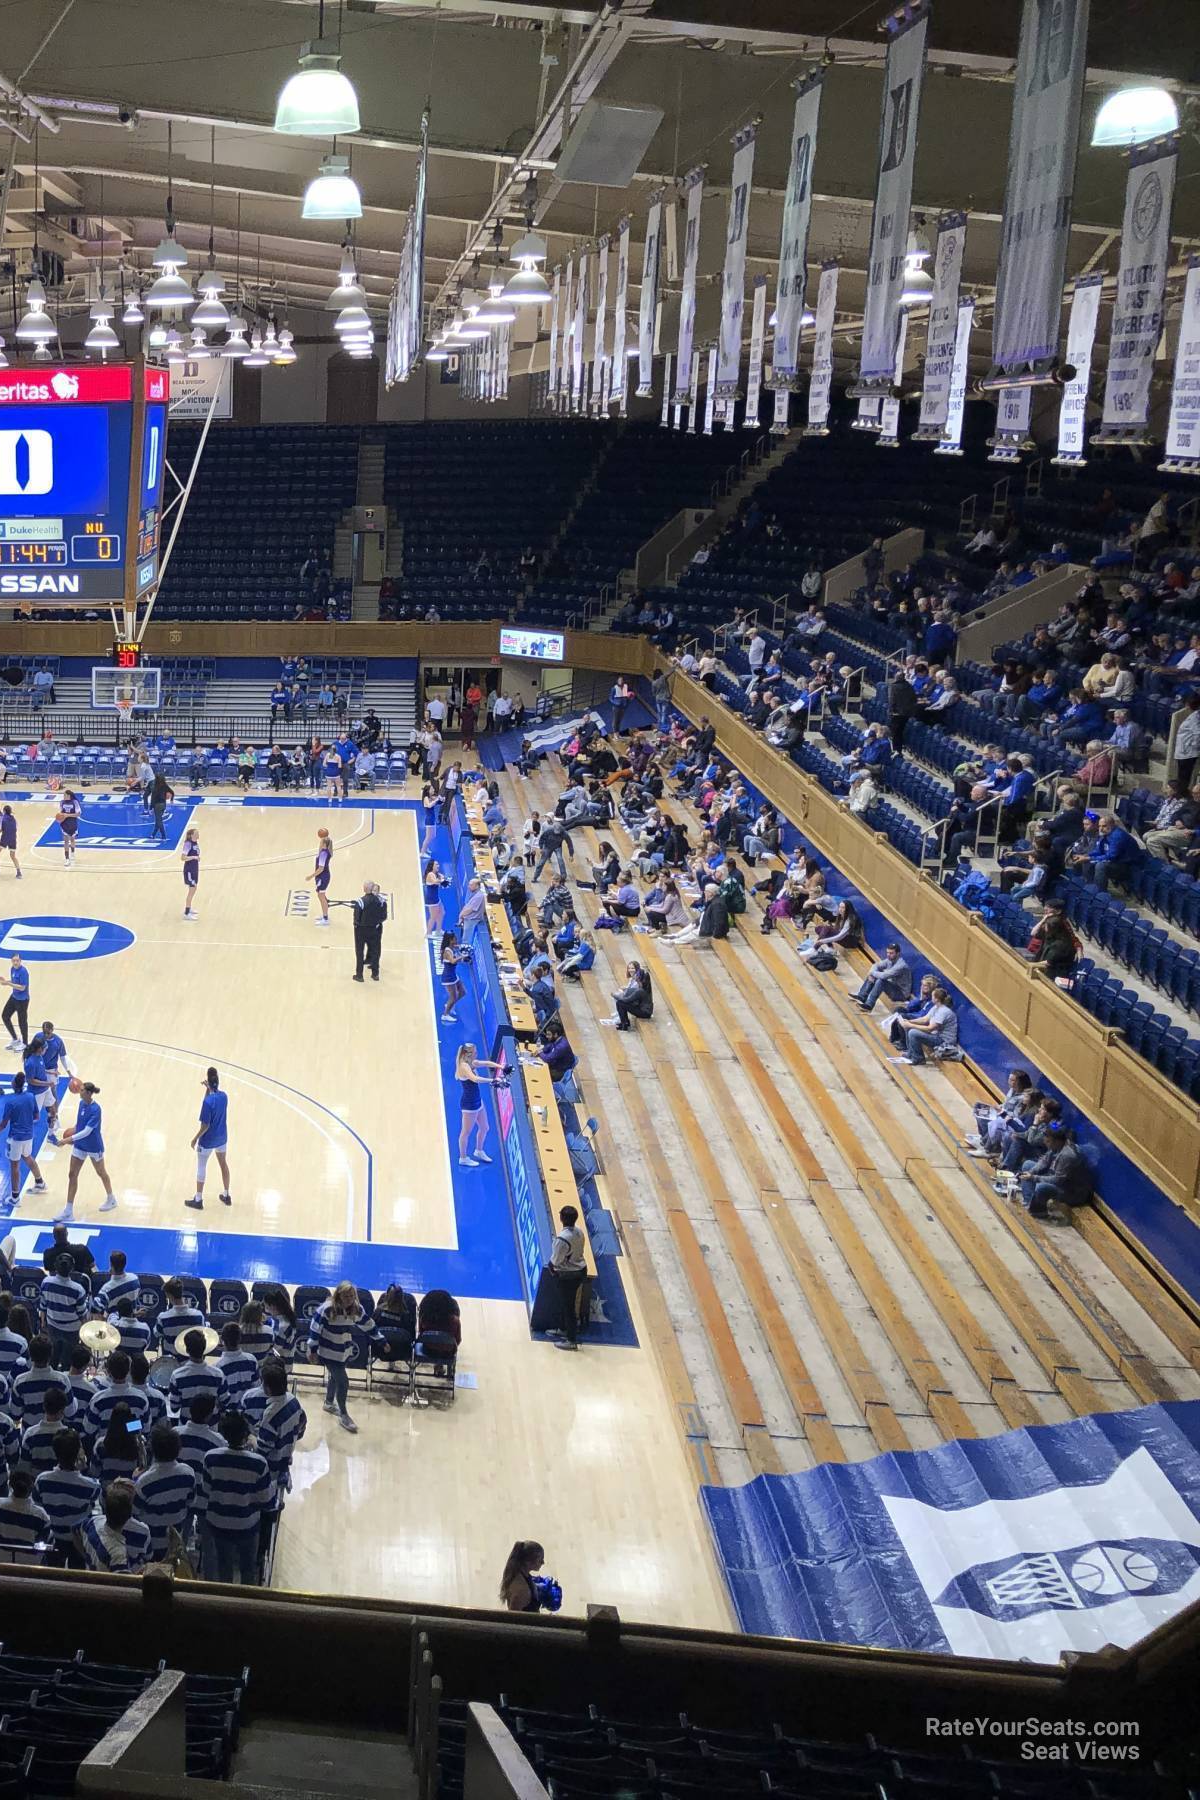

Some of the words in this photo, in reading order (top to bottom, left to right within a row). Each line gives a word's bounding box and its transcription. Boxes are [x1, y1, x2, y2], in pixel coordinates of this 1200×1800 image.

[85, 523, 104, 534] NU
[97, 538, 111, 559] 0
[119, 652, 135, 667] 30
[45, 836, 171, 848] ACC
